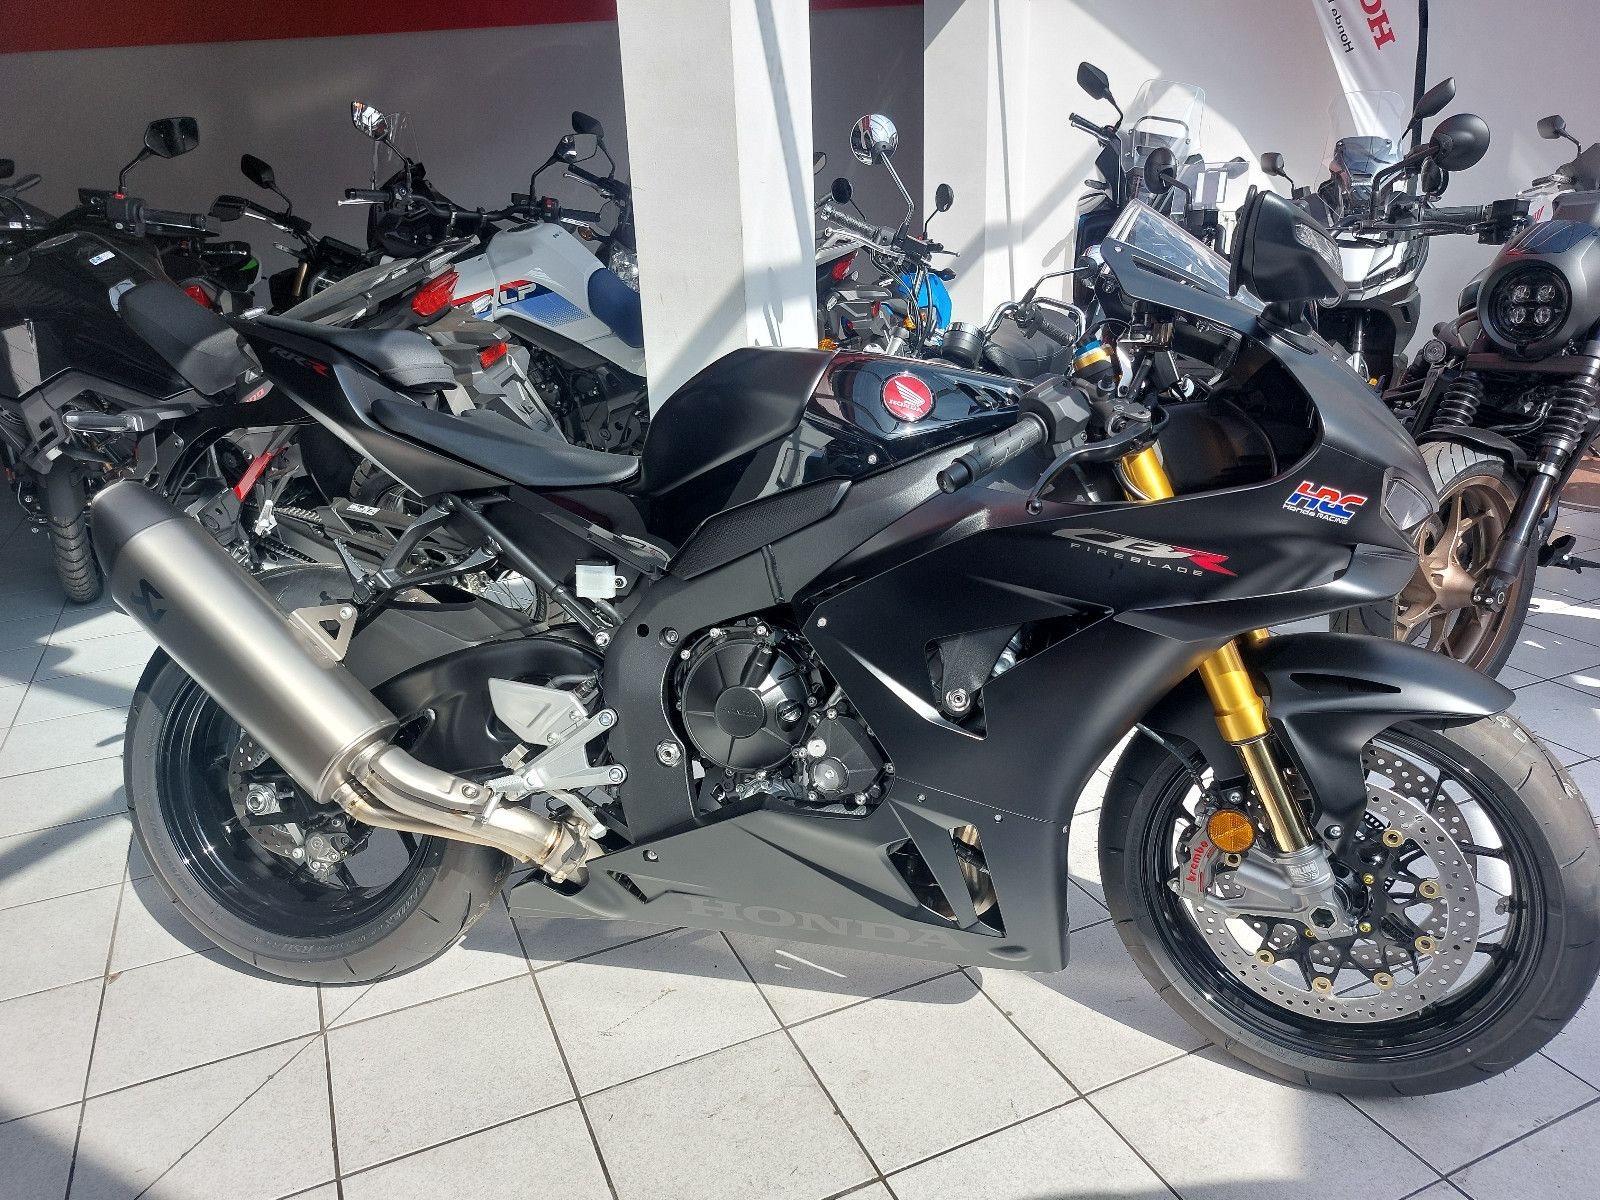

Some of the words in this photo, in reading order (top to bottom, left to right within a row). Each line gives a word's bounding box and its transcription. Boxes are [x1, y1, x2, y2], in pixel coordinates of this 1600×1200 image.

[889, 399, 924, 413] HONDA
[1282, 503, 1316, 517] Honda
[1316, 512, 1349, 525] RACING
[1285, 480, 1368, 520] HRC
[1052, 528, 1238, 577] CBR
[1186, 840, 1208, 883] brembo
[688, 899, 969, 951] HONDA
